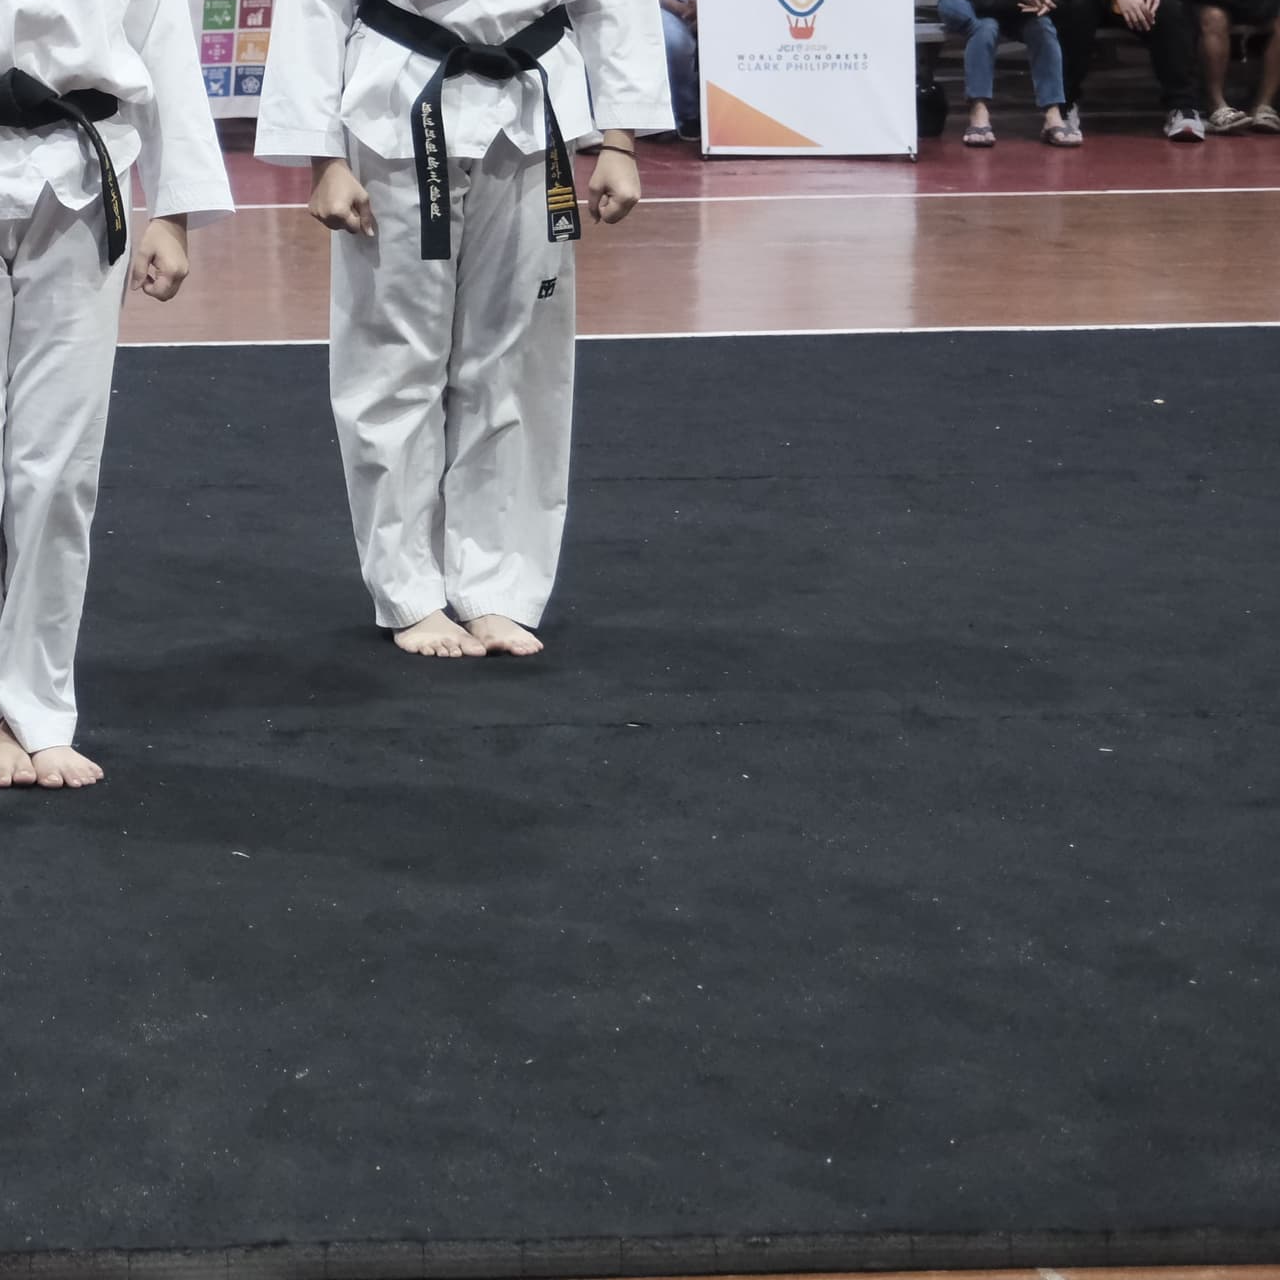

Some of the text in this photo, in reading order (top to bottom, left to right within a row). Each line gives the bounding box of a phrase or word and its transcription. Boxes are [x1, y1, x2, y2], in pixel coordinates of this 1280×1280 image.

[793, 53, 869, 61] CONGRESS
[737, 62, 869, 71] CLARK PHILIPPINES
